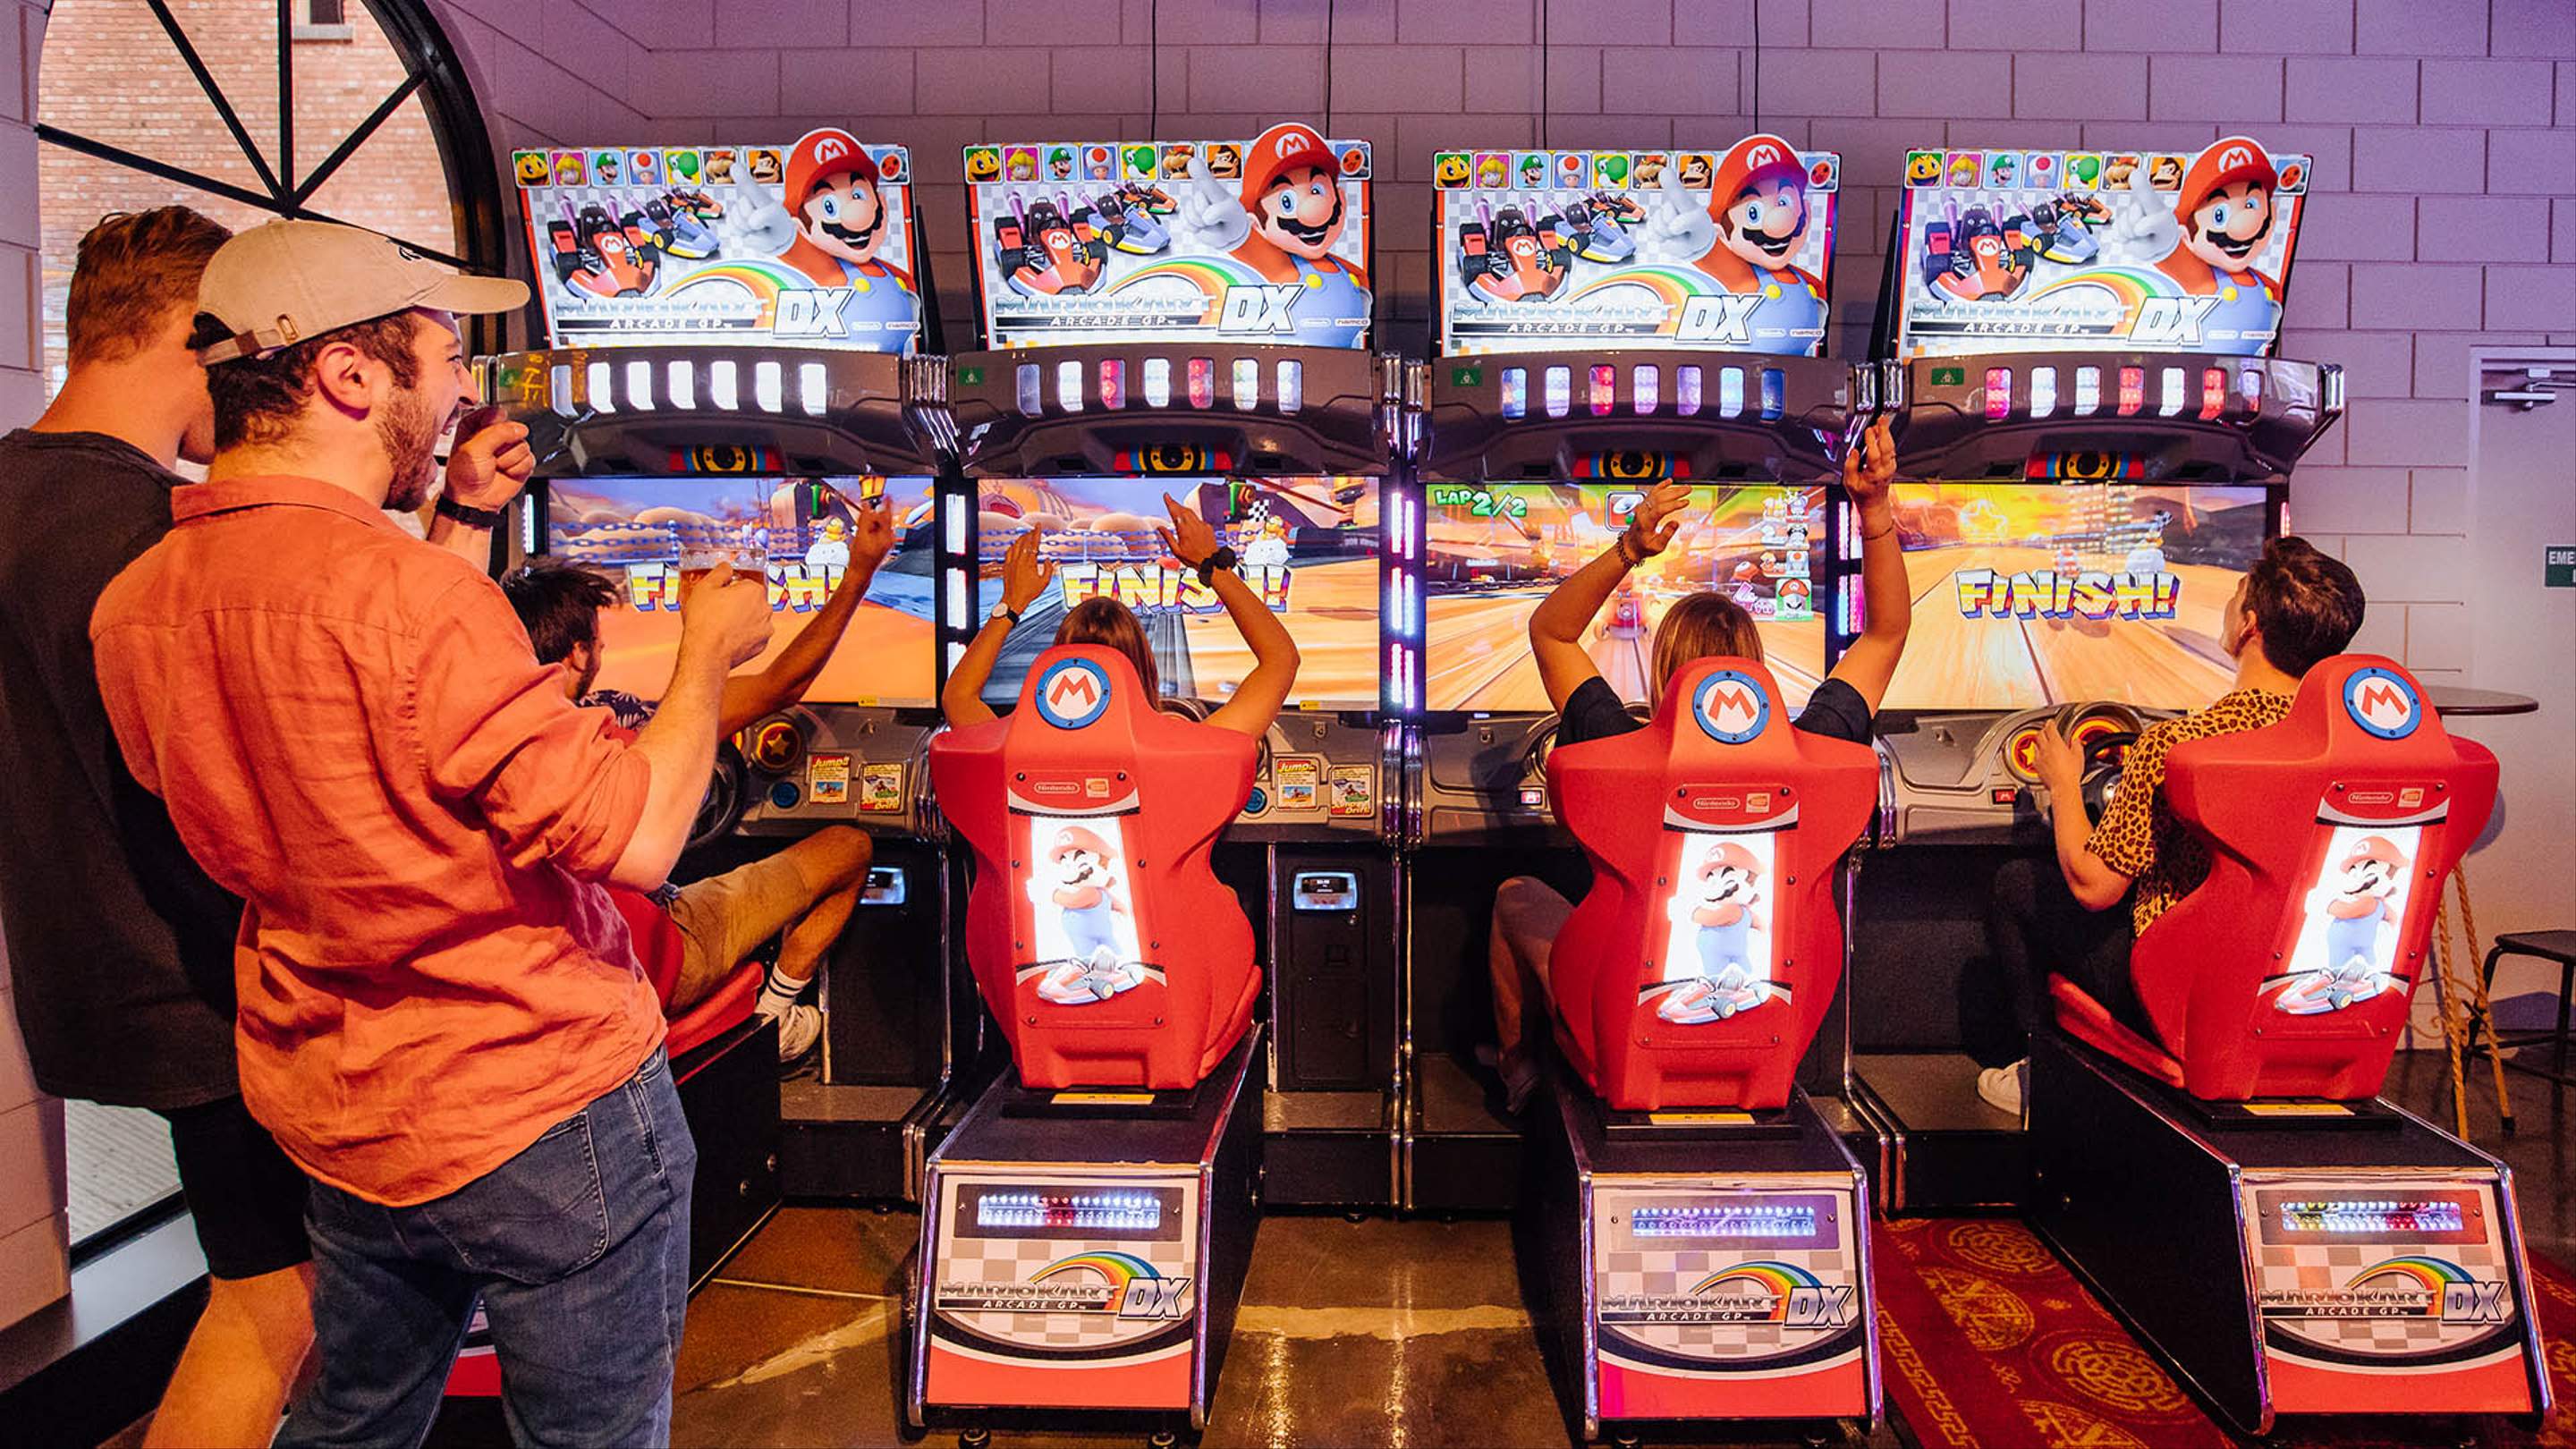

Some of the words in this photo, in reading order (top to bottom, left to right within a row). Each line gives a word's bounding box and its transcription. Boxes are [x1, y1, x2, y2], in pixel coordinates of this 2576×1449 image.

[820, 140, 845, 163] M
[1281, 135, 1309, 159] M
[1752, 148, 1780, 169] M
[2224, 150, 2250, 171] M
[773, 287, 853, 338] DX
[1217, 284, 1305, 334] DX
[1674, 294, 1765, 343] DX
[2127, 296, 2223, 345] DX
[1435, 489, 1473, 505] LAP
[1471, 490, 1527, 517] 2/2
[1953, 569, 2180, 621] FINISH!
[1050, 674, 1097, 707] M
[1708, 687, 1757, 721] M
[2360, 685, 2409, 716] M
[982, 1301, 1047, 1309] ARCADE
[1119, 1277, 1191, 1319] DX
[1784, 1286, 1852, 1327] DX
[2305, 1307, 2369, 1316] ARCADE
[2441, 1281, 2506, 1324] DX
[1646, 1312, 1712, 1321] ARCADE
